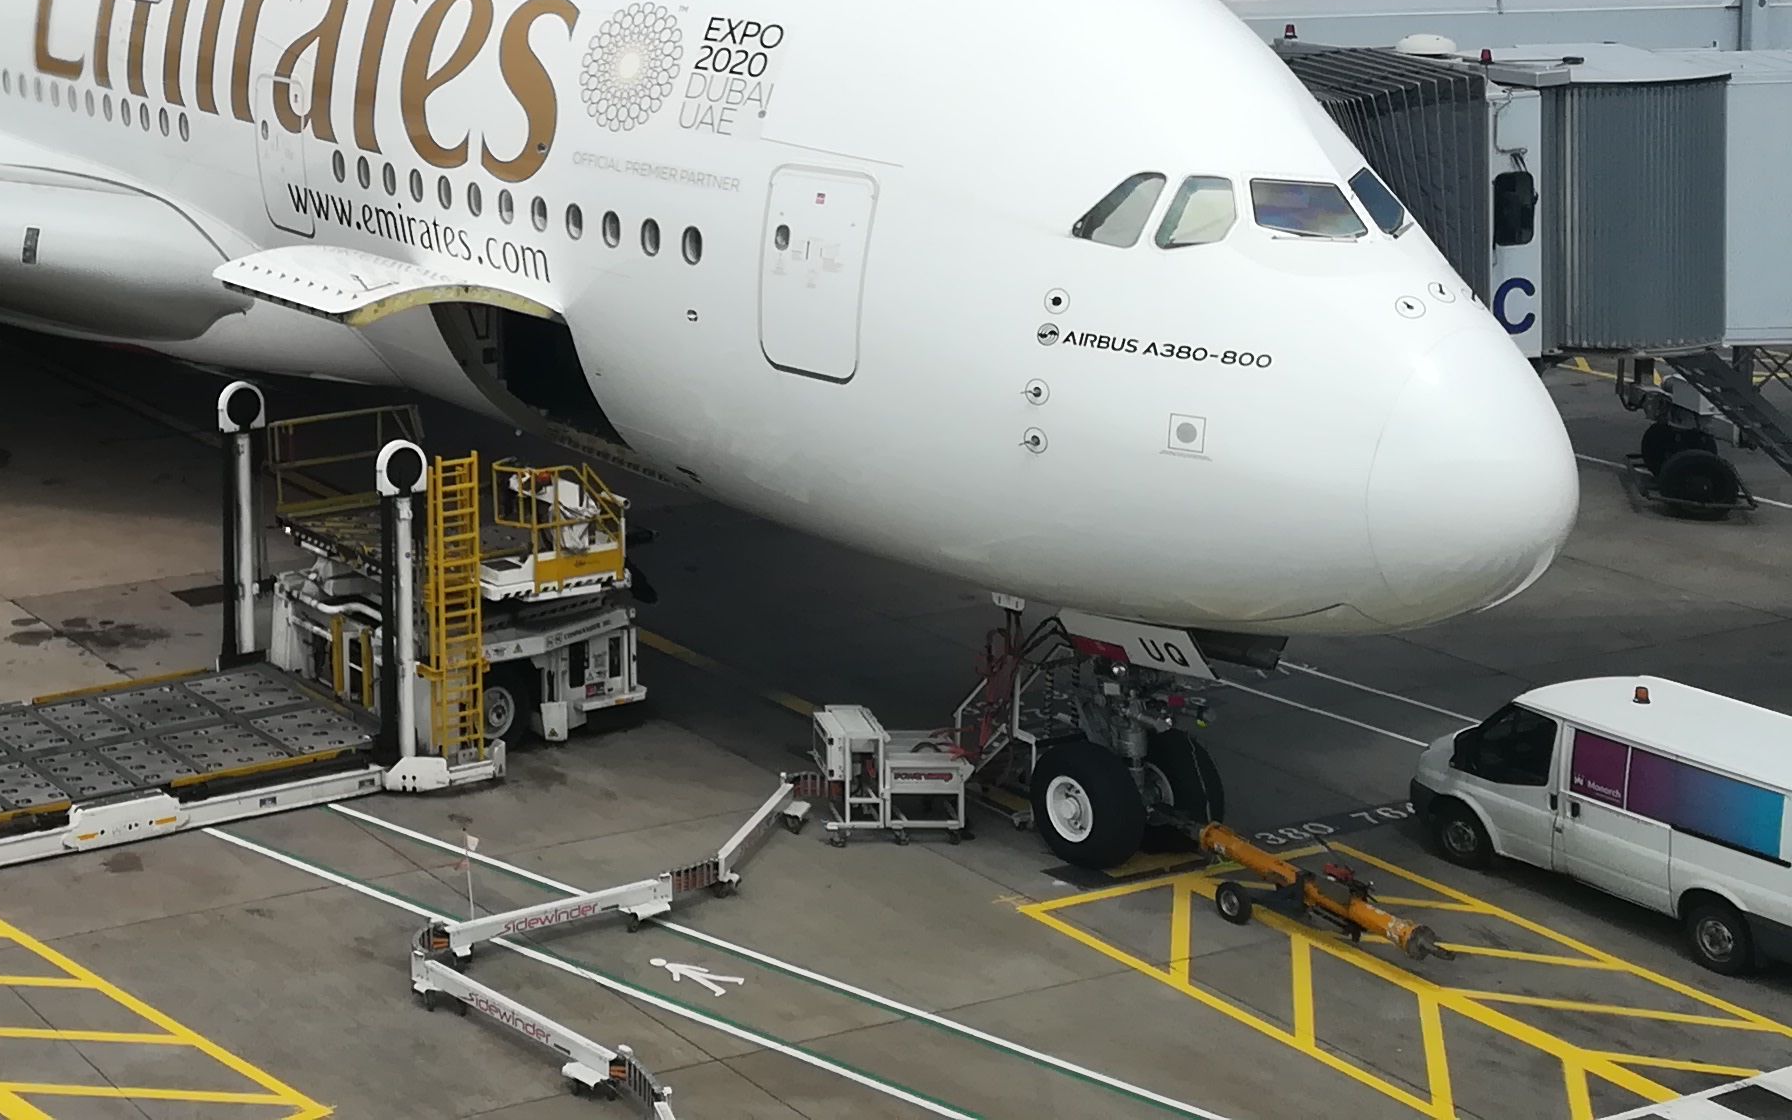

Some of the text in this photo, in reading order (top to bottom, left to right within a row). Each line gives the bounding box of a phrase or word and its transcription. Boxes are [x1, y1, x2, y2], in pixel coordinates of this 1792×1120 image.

[703, 16, 785, 49] EXPO
[693, 45, 769, 78] 2020
[679, 101, 738, 136] UAE
[572, 150, 742, 193] OFFICIAL PREMIER PARTNER
[287, 182, 551, 283] www.emirates.com
[1493, 277, 1536, 335] C
[1062, 330, 1273, 369] AIRBUS A380-800
[1138, 636, 1190, 668] UQ
[1587, 779, 1622, 799] Monarch
[1255, 822, 1335, 845] 380
[491, 902, 599, 939] sidewinder
[460, 992, 552, 1044] sidewinder
